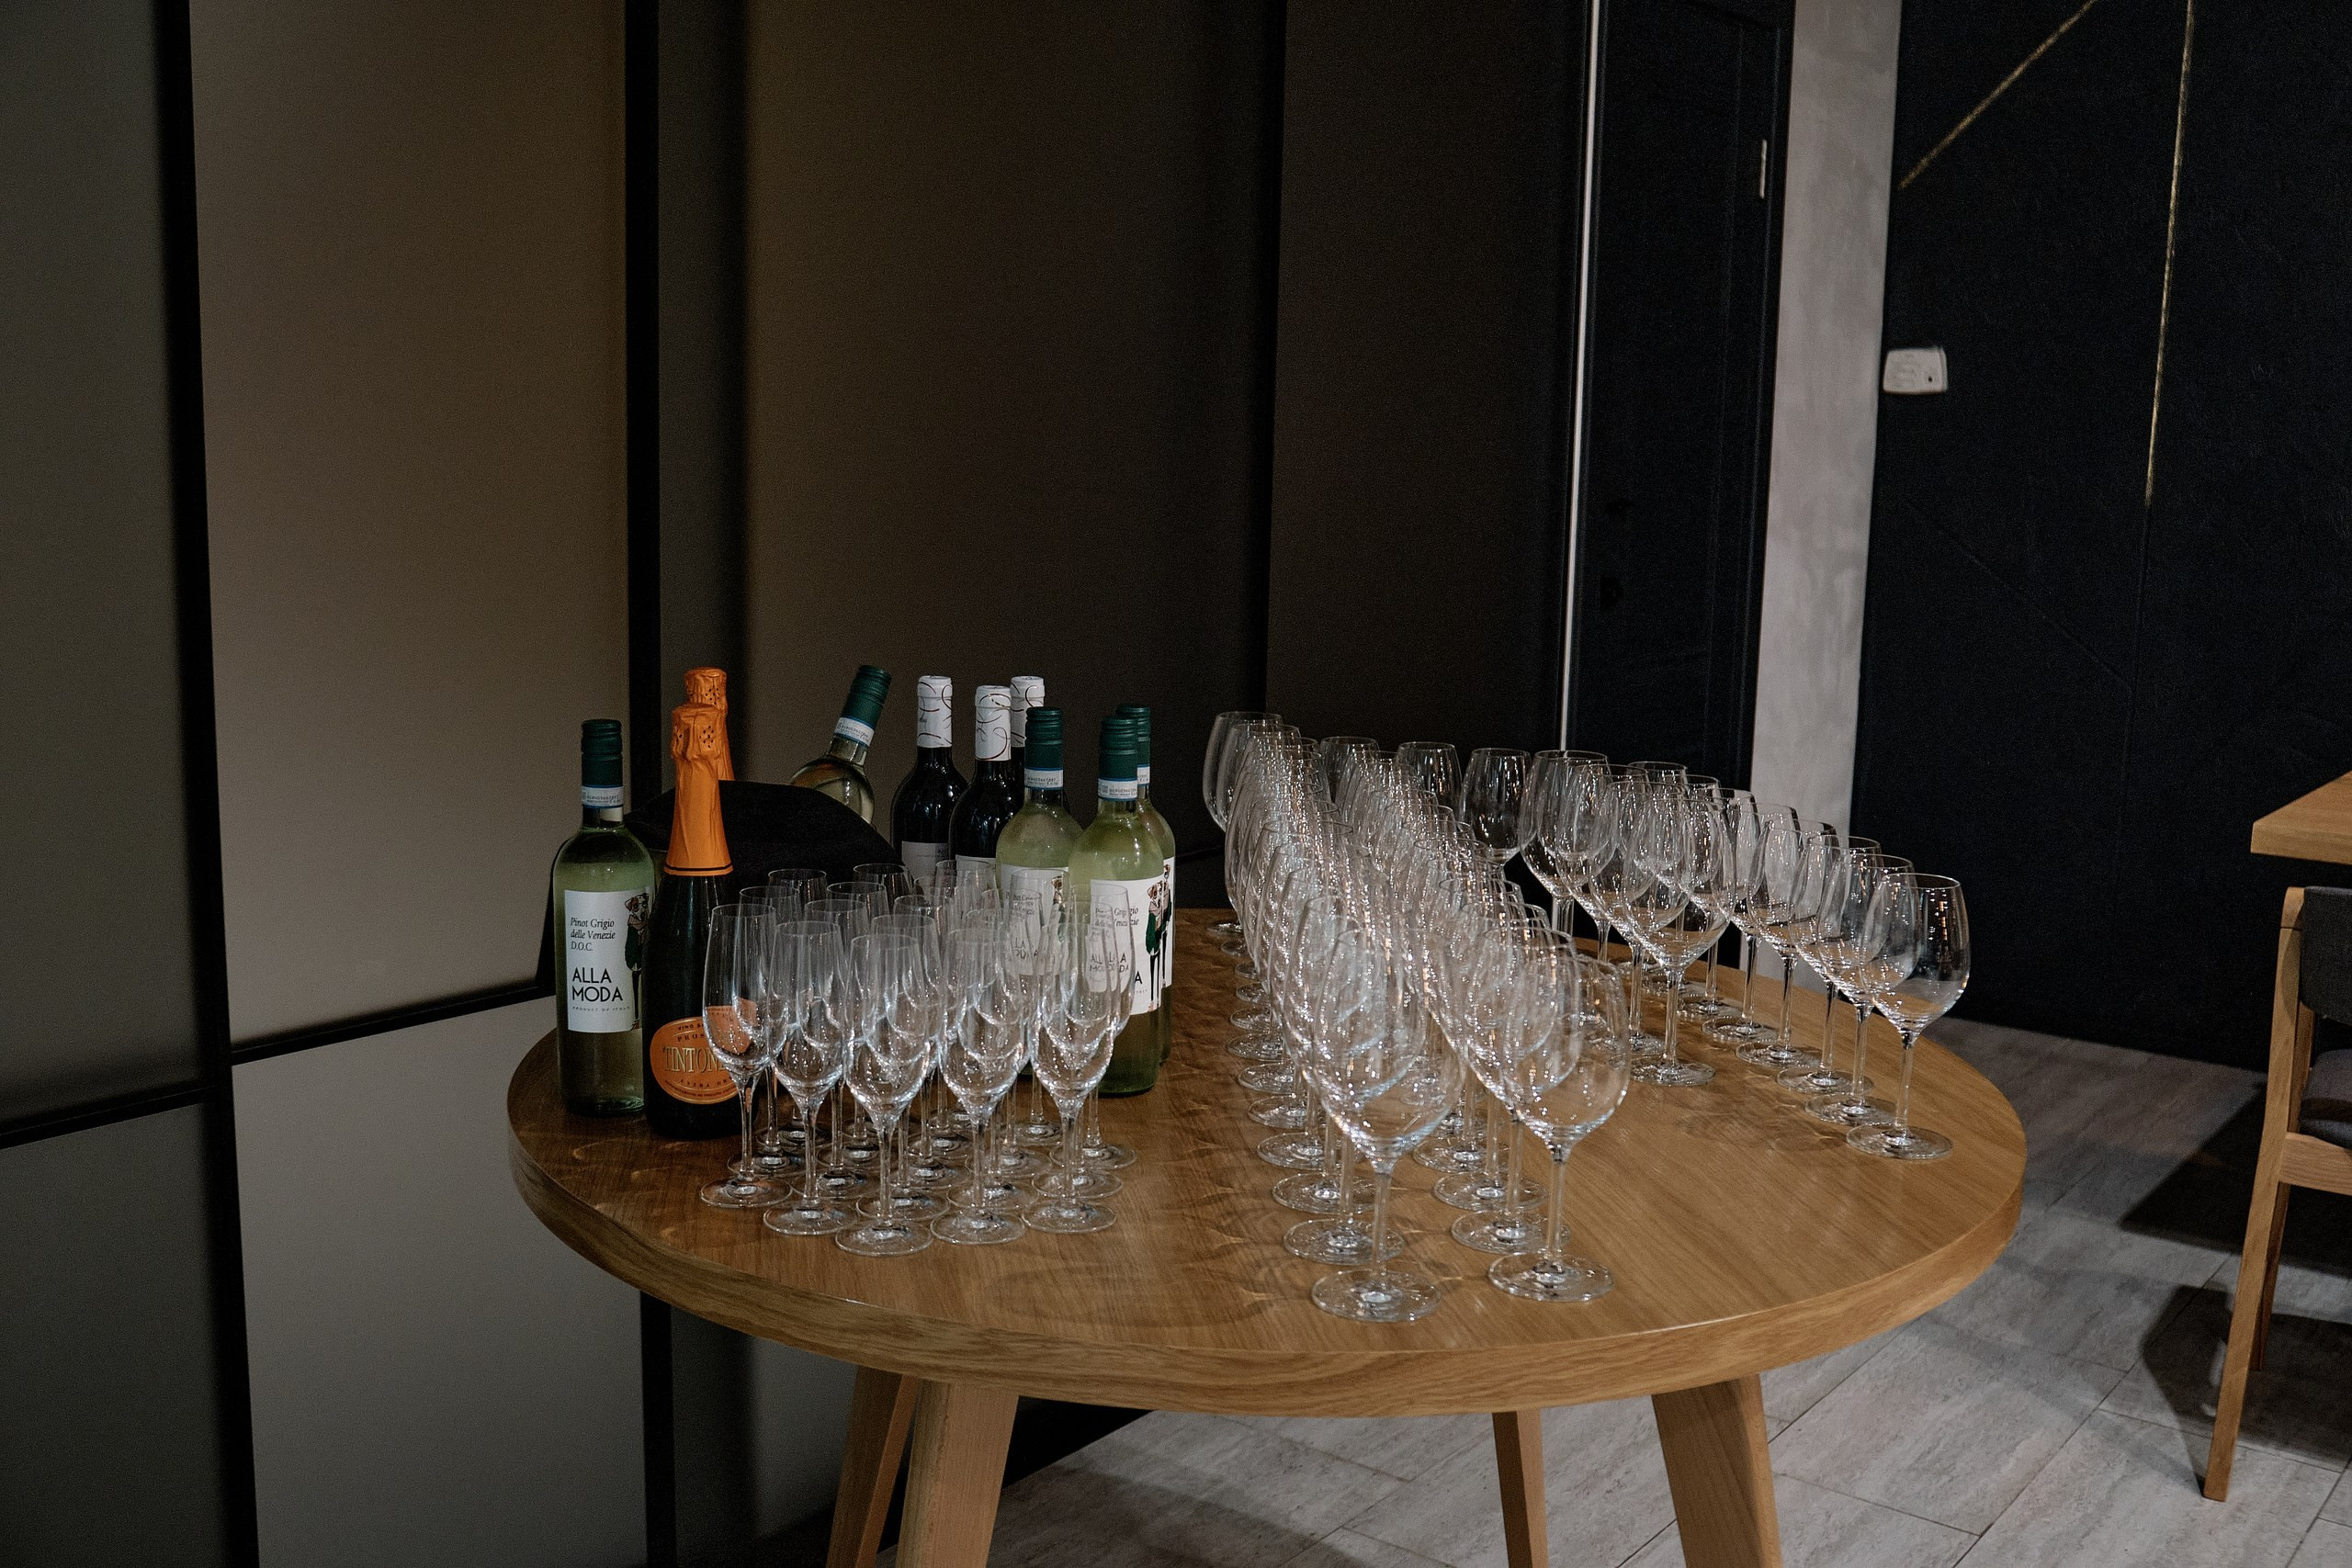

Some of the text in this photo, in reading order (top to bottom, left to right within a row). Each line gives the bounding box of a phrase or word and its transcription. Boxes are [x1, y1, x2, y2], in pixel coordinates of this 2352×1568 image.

[570, 917, 615, 930] Pinot Grigio
[571, 929, 616, 940] delle Venezie
[571, 942, 594, 952] D.O.C.
[572, 967, 612, 984] ALLA
[572, 986, 624, 1003] MODA
[677, 1022, 695, 1031] VINO
